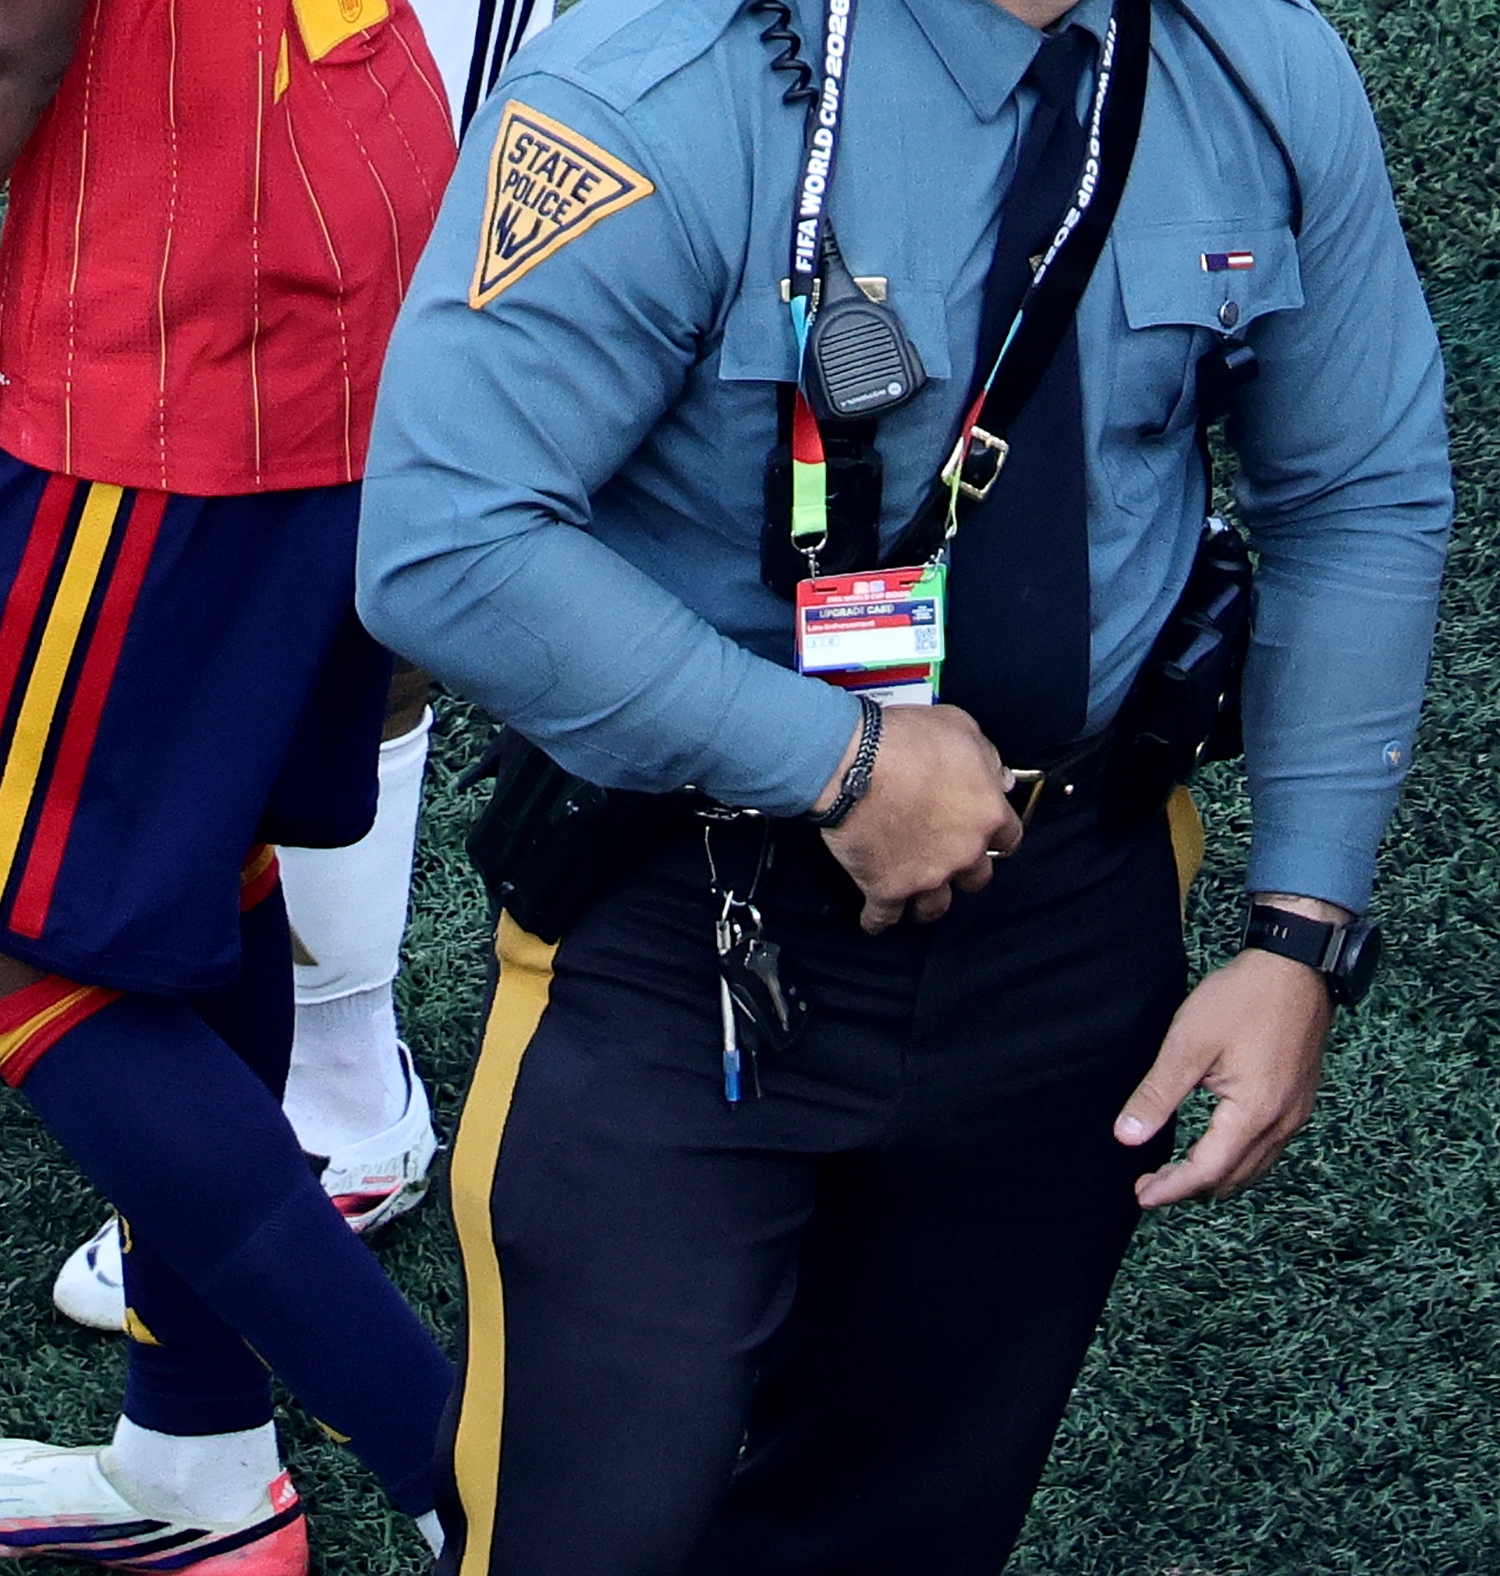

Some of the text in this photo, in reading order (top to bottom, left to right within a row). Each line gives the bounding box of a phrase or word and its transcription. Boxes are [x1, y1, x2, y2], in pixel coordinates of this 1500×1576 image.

[820, 77, 839, 125] CUP
[508, 132, 600, 204] STATE
[800, 127, 834, 216] WORLD
[1077, 159, 1098, 208] CUP
[501, 168, 571, 226] POLICE
[795, 218, 817, 273] FIFA
[866, 604, 895, 615] CARD
